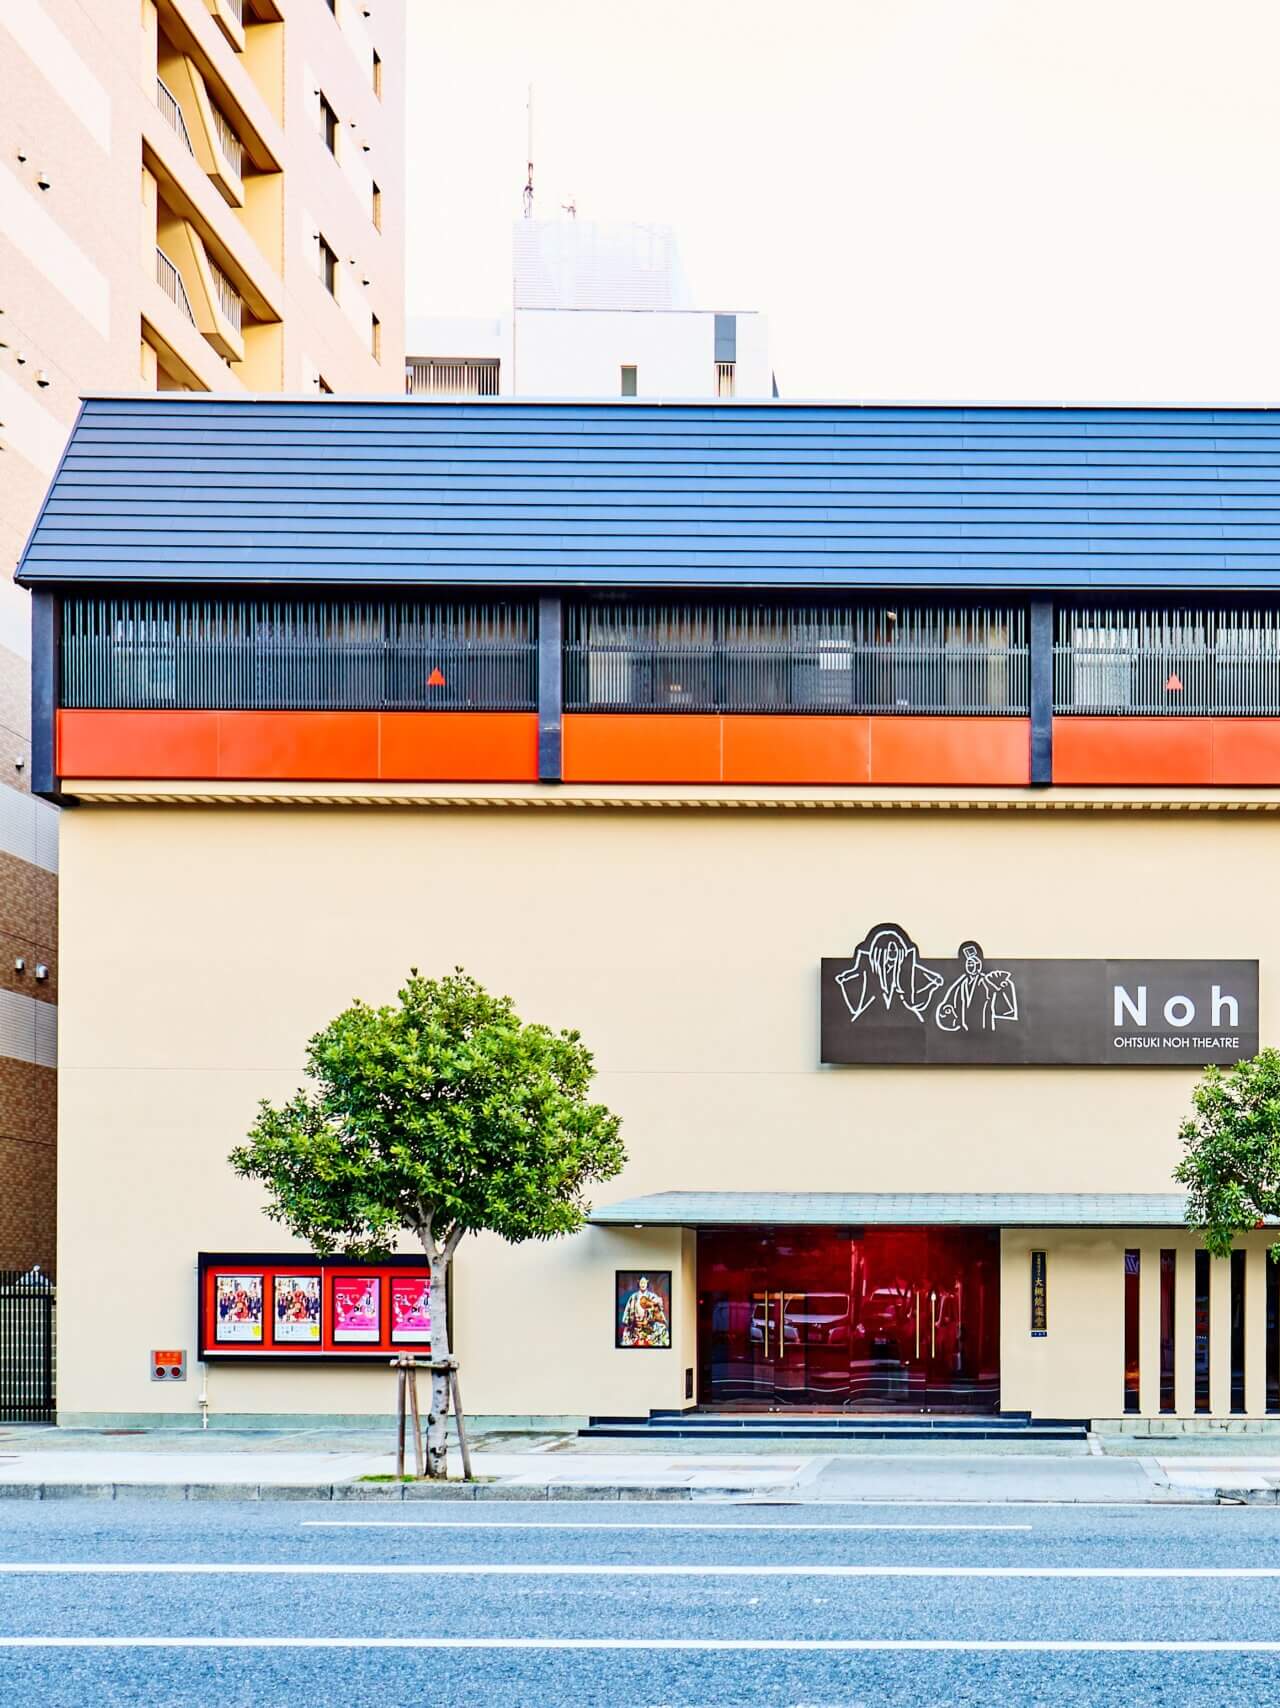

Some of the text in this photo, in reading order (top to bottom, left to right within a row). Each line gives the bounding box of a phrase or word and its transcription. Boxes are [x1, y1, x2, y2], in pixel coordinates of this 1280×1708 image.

[1113, 985, 1239, 1027] Noh
[1113, 1036, 1240, 1048] OHTSUKI NOH THEATRE
